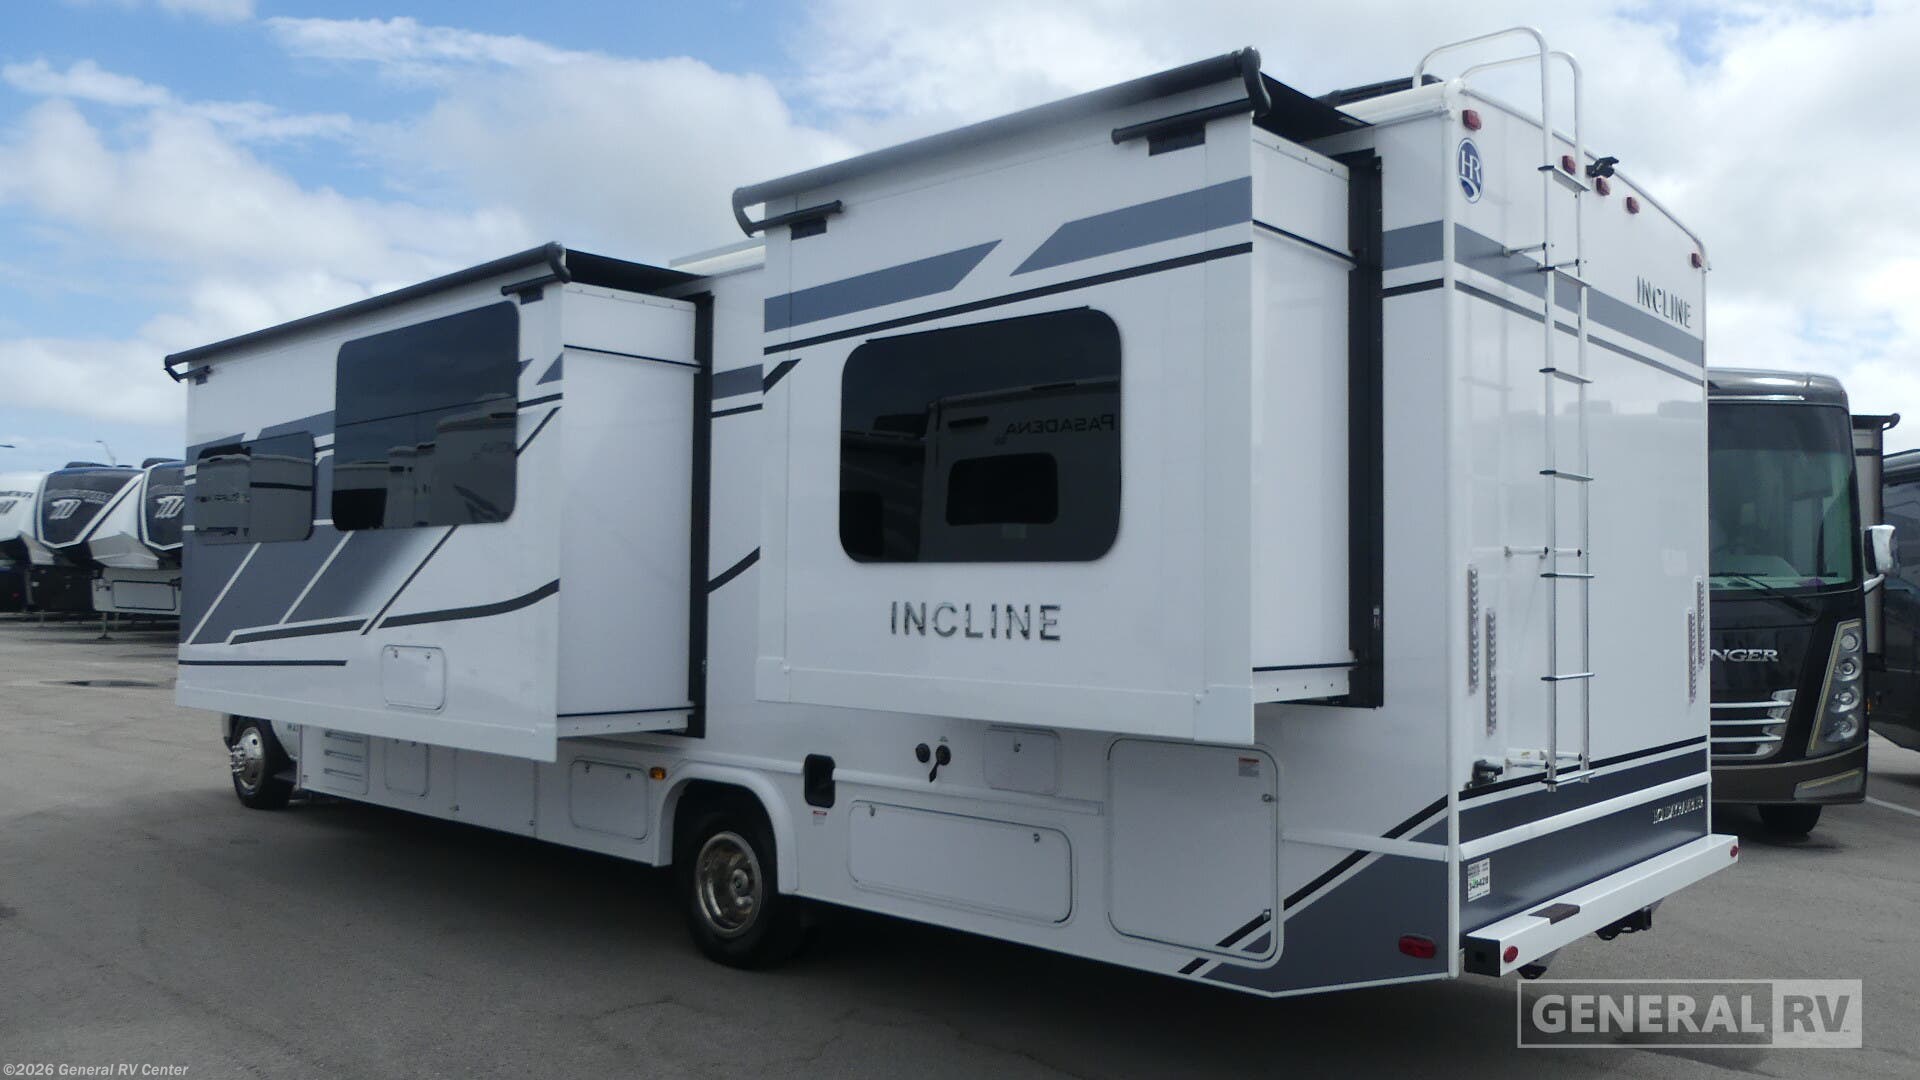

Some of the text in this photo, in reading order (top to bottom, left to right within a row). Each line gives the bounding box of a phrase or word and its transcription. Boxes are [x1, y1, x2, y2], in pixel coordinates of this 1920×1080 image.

[1461, 150, 1480, 184] HR
[1637, 275, 1690, 329] INCLINE
[891, 601, 1061, 641] INCLINE
